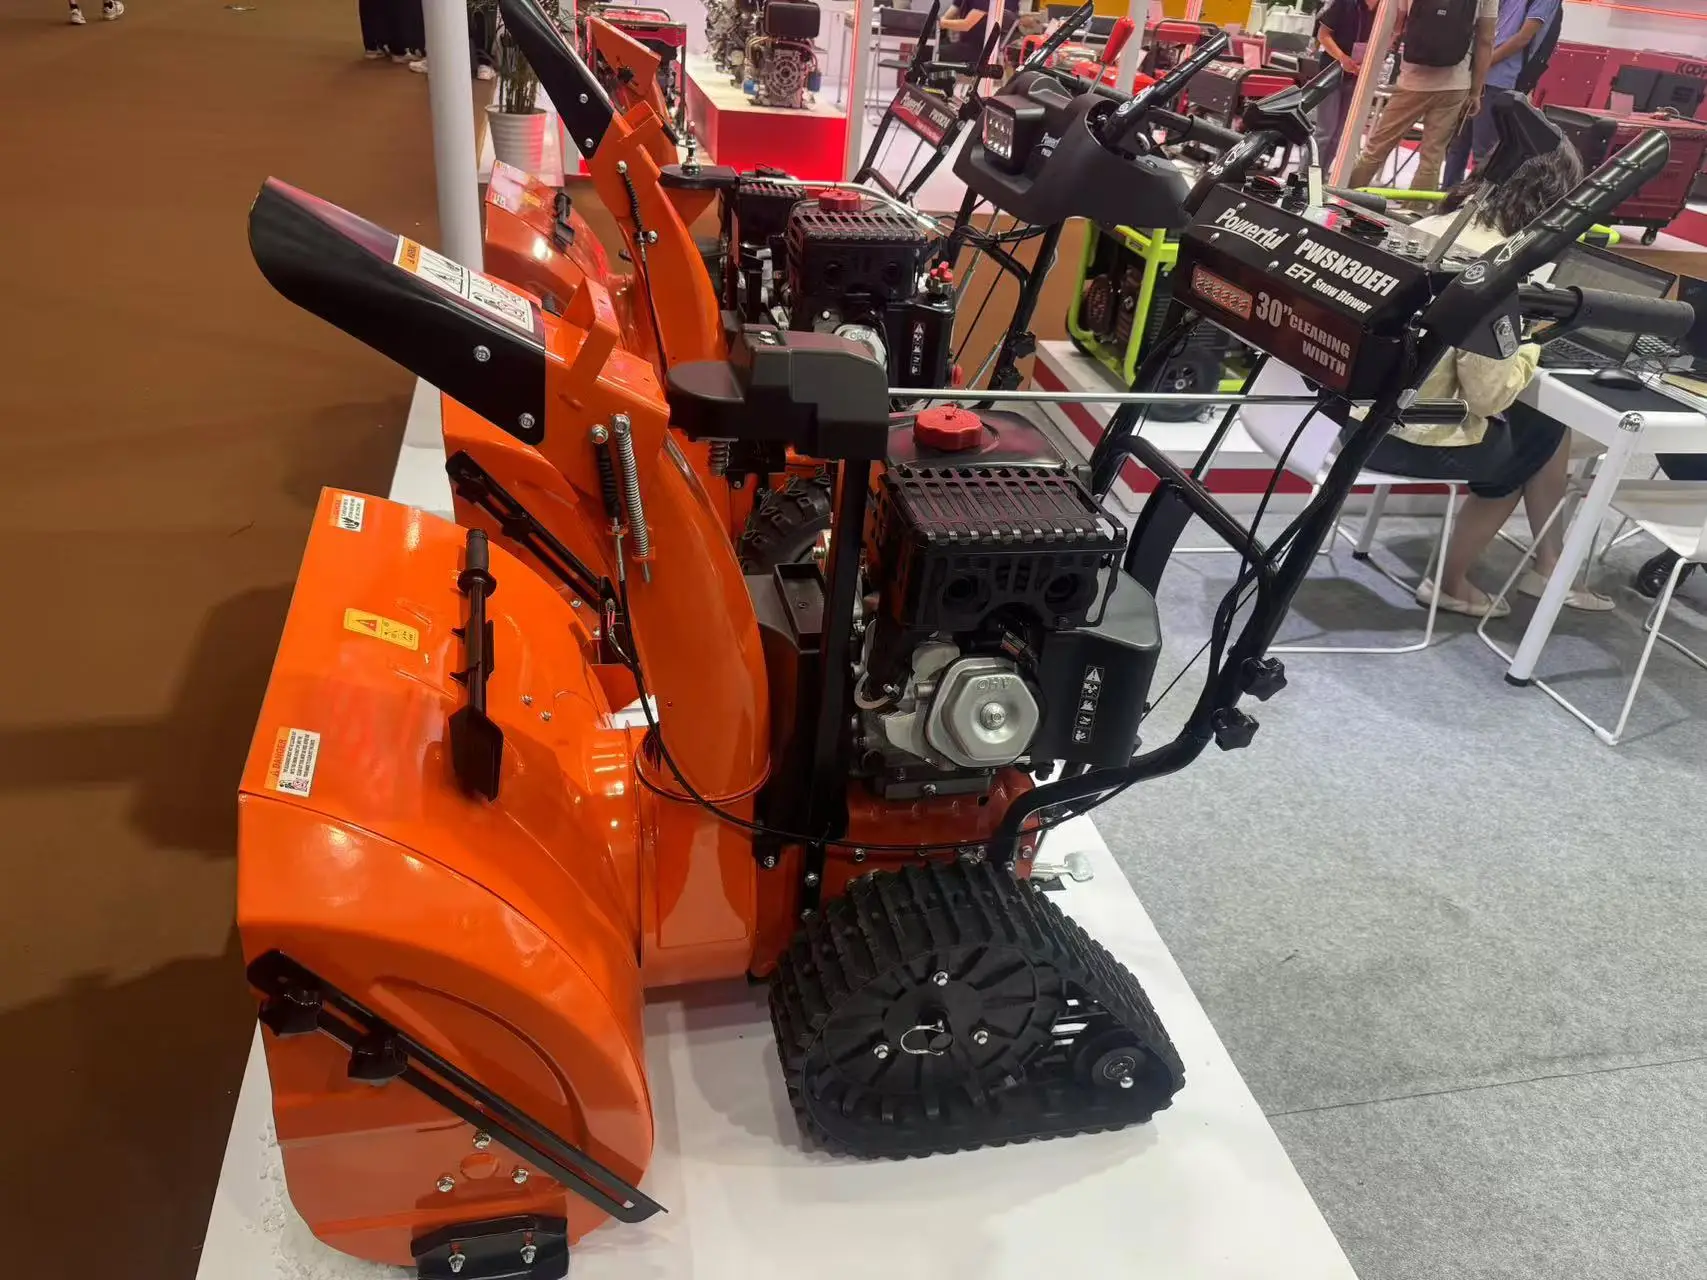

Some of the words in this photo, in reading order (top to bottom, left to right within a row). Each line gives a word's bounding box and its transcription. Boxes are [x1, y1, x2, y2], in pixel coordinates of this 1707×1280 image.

[1215, 207, 1290, 250] Powerful
[1284, 262, 1316, 284] EFI
[1312, 278, 1339, 298] Snow
[1335, 290, 1372, 314] Blower
[1294, 238, 1400, 297] PWSN30EFI
[1289, 315, 1351, 359] CLEARING
[1302, 340, 1346, 377] WIDTH
